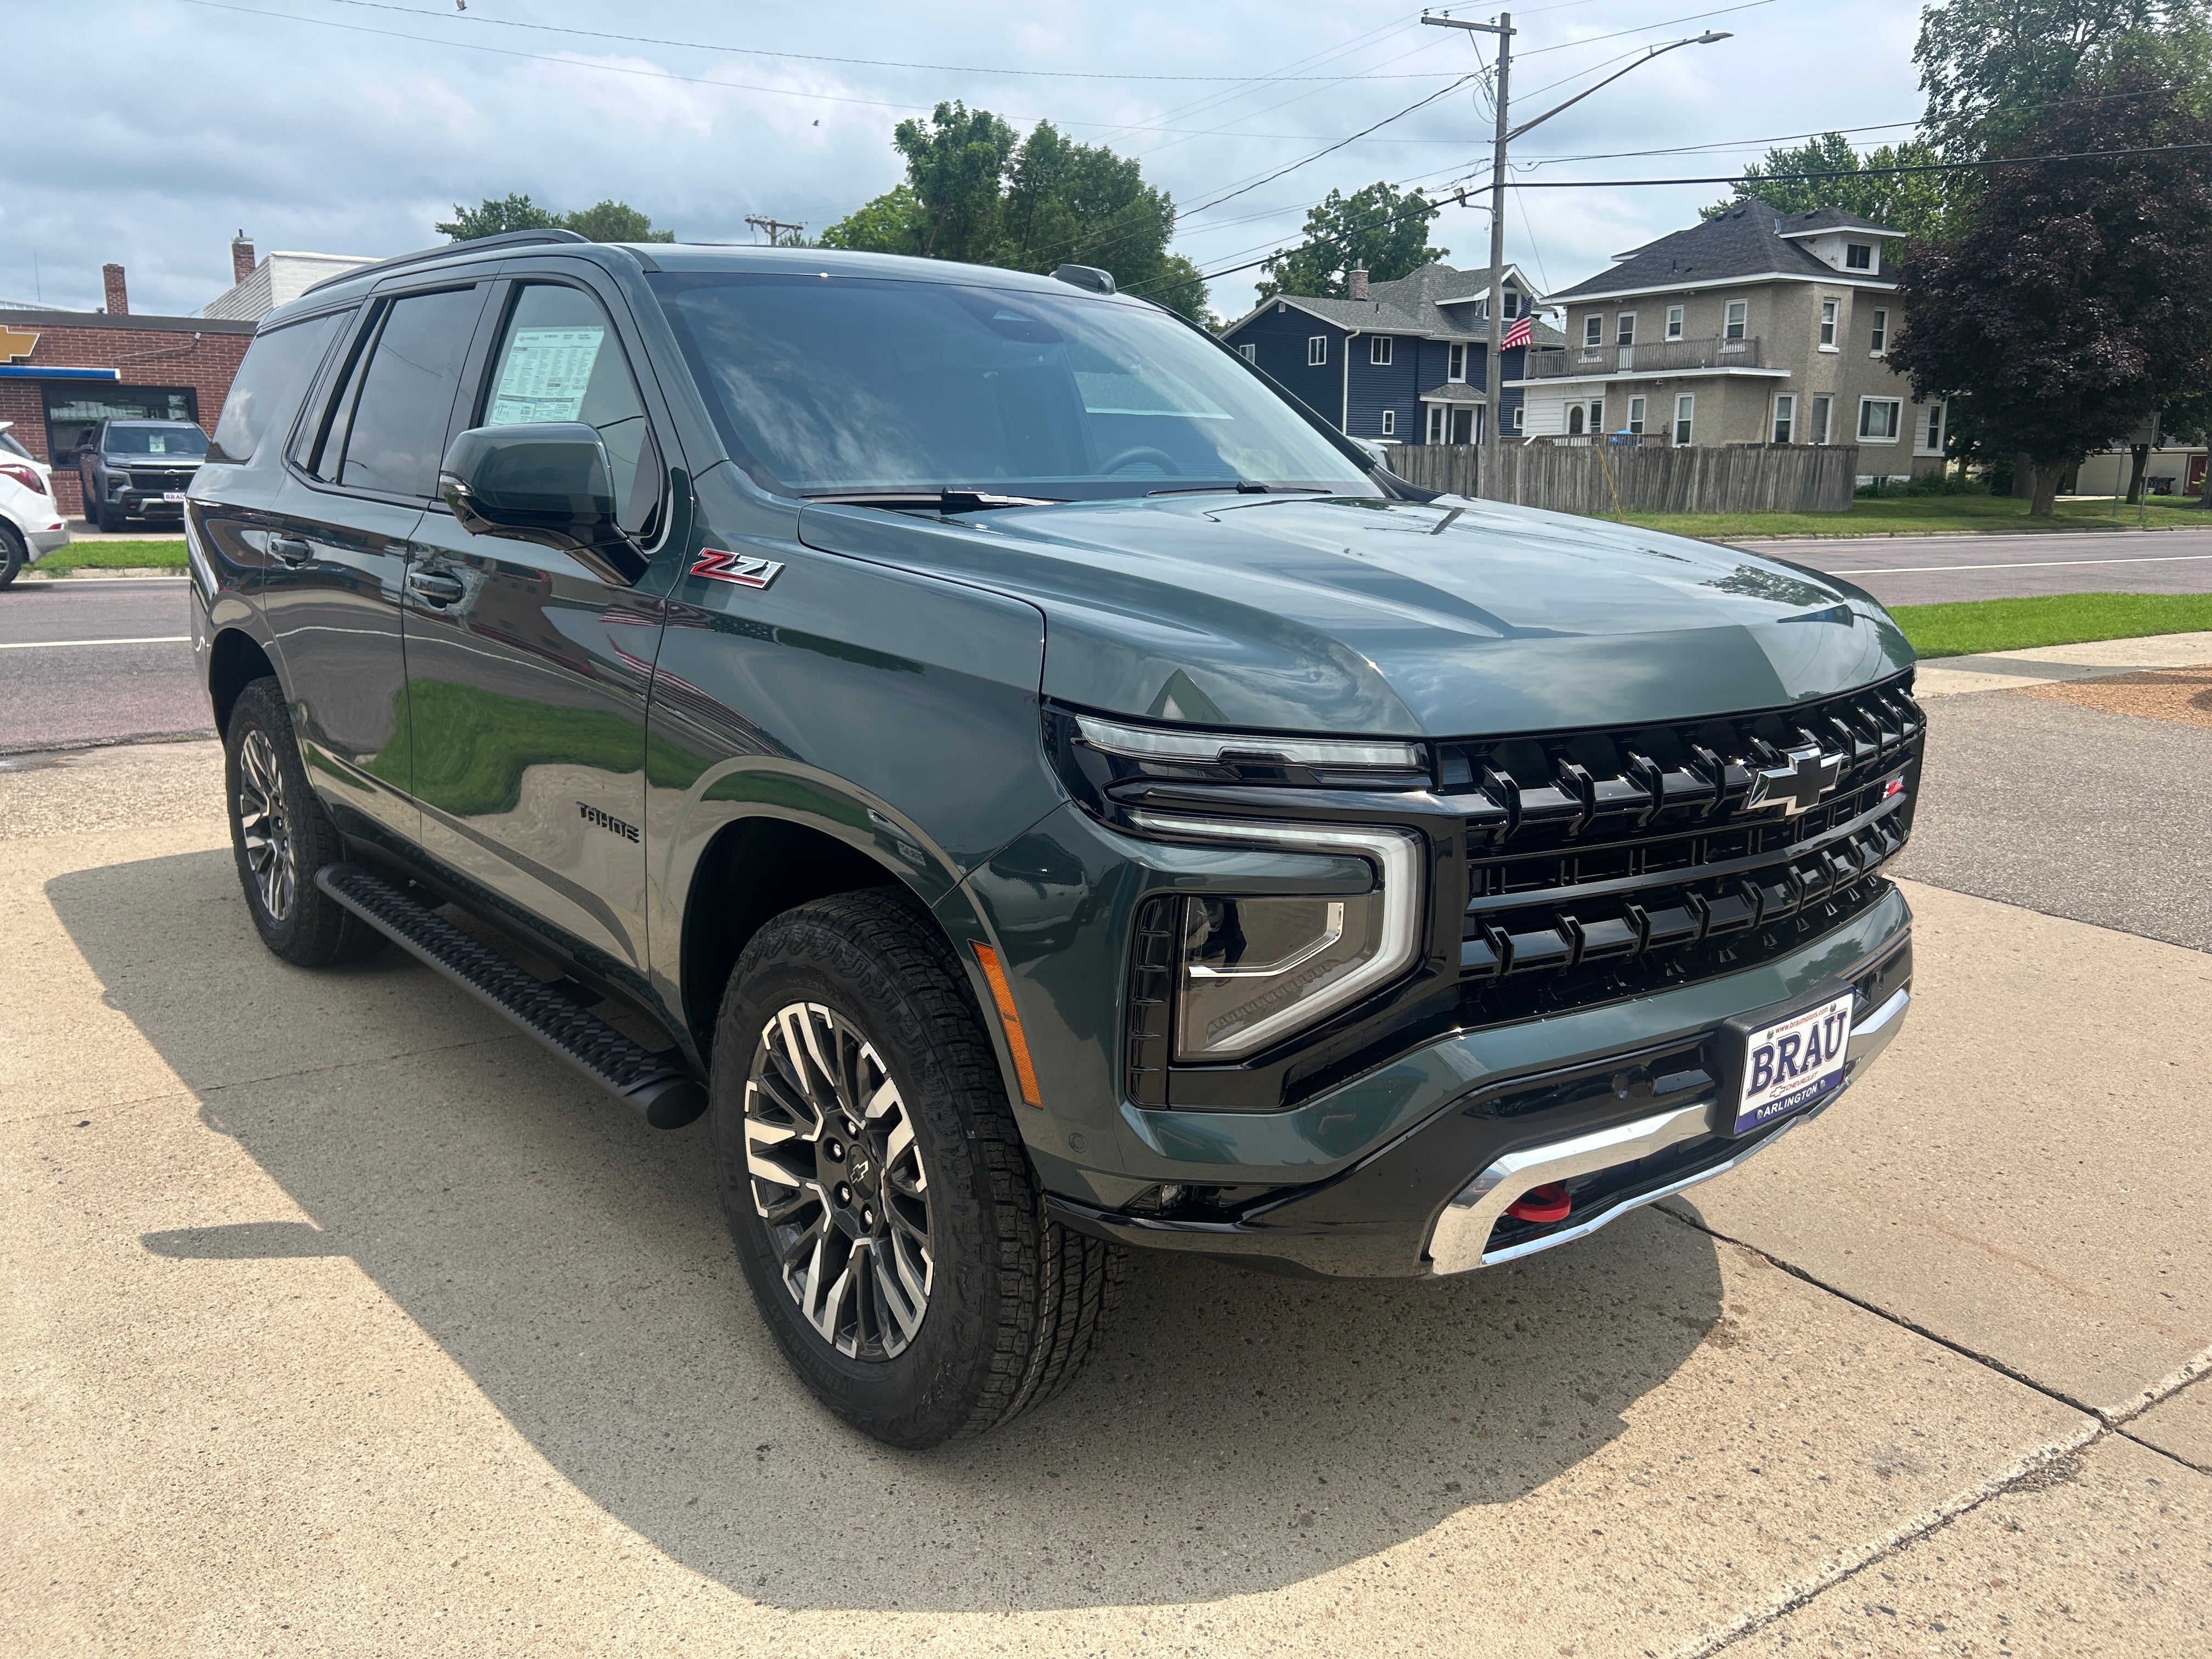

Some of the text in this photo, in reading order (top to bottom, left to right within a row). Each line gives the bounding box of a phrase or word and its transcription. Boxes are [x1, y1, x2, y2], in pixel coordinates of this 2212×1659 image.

[689, 548, 785, 589] Z71
[575, 801, 640, 843] TAHOE
[1775, 1007, 1828, 1033] www.braumotors.com
[1746, 1008, 1848, 1099] BRAU
[1785, 1071, 1819, 1091] CHEVROLET
[1763, 1083, 1818, 1118] ARLINGTON
